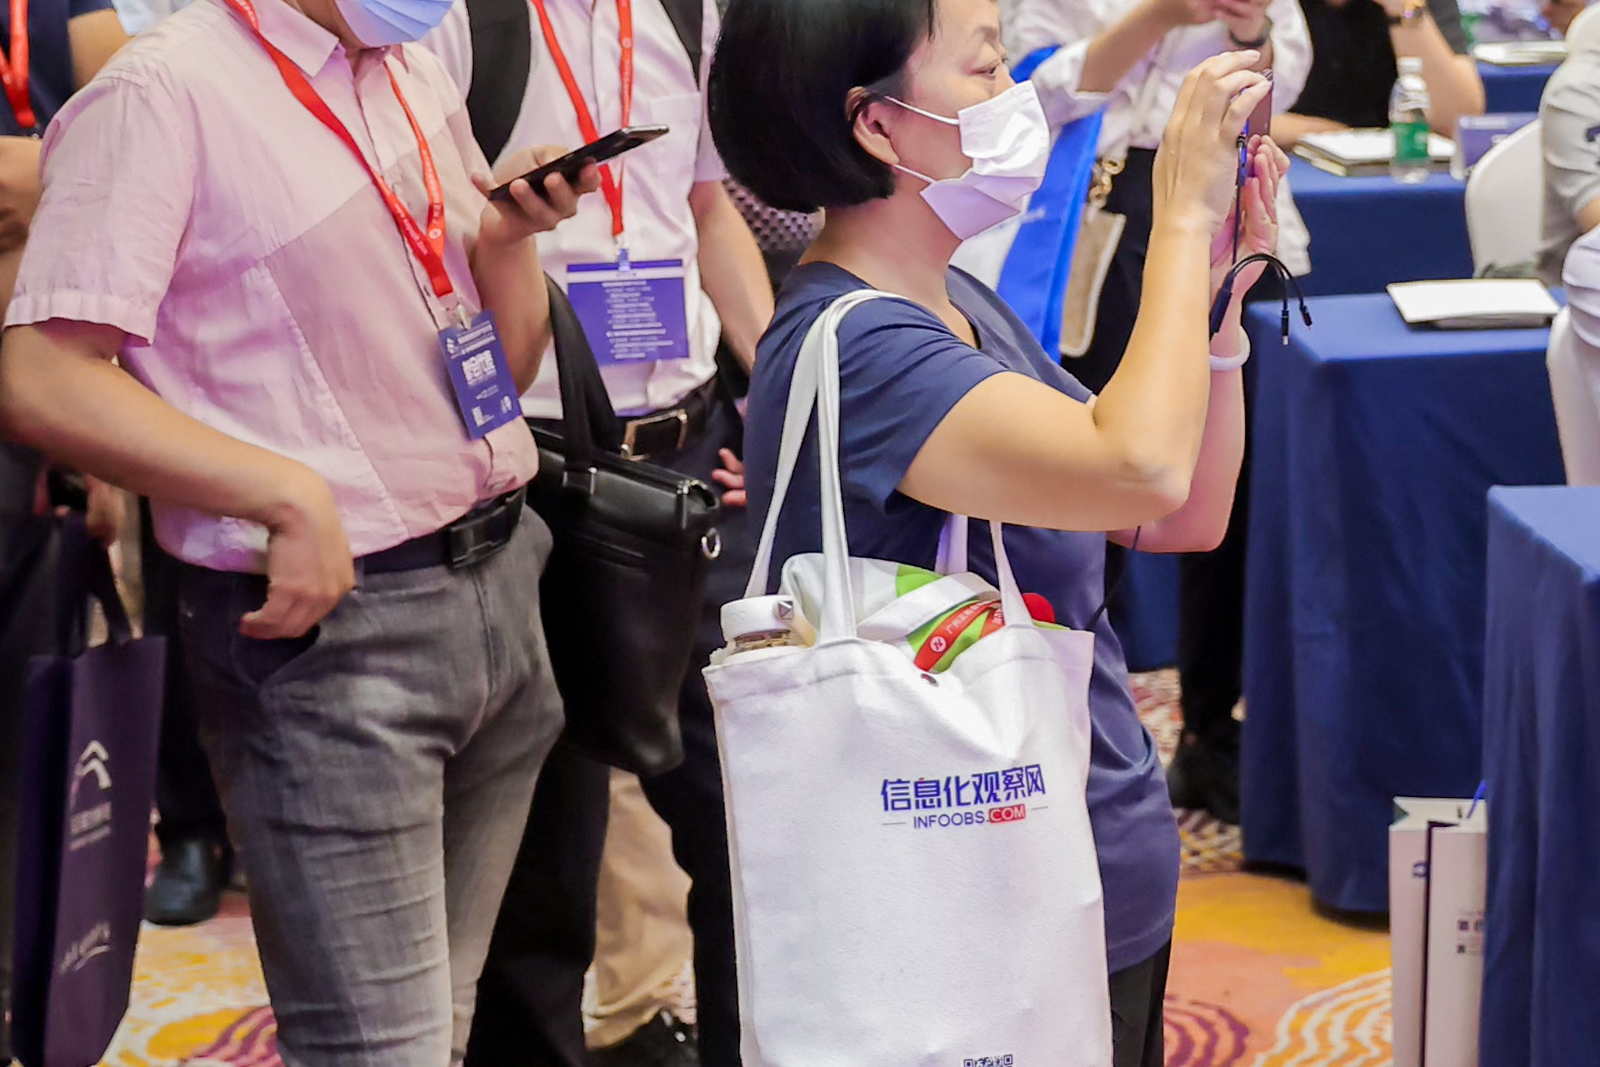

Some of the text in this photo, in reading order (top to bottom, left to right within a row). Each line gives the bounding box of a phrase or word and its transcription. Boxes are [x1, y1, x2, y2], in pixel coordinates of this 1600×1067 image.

[881, 764, 1046, 812] 信息化观察网
[913, 803, 1026, 830] INFOOBS.COM
